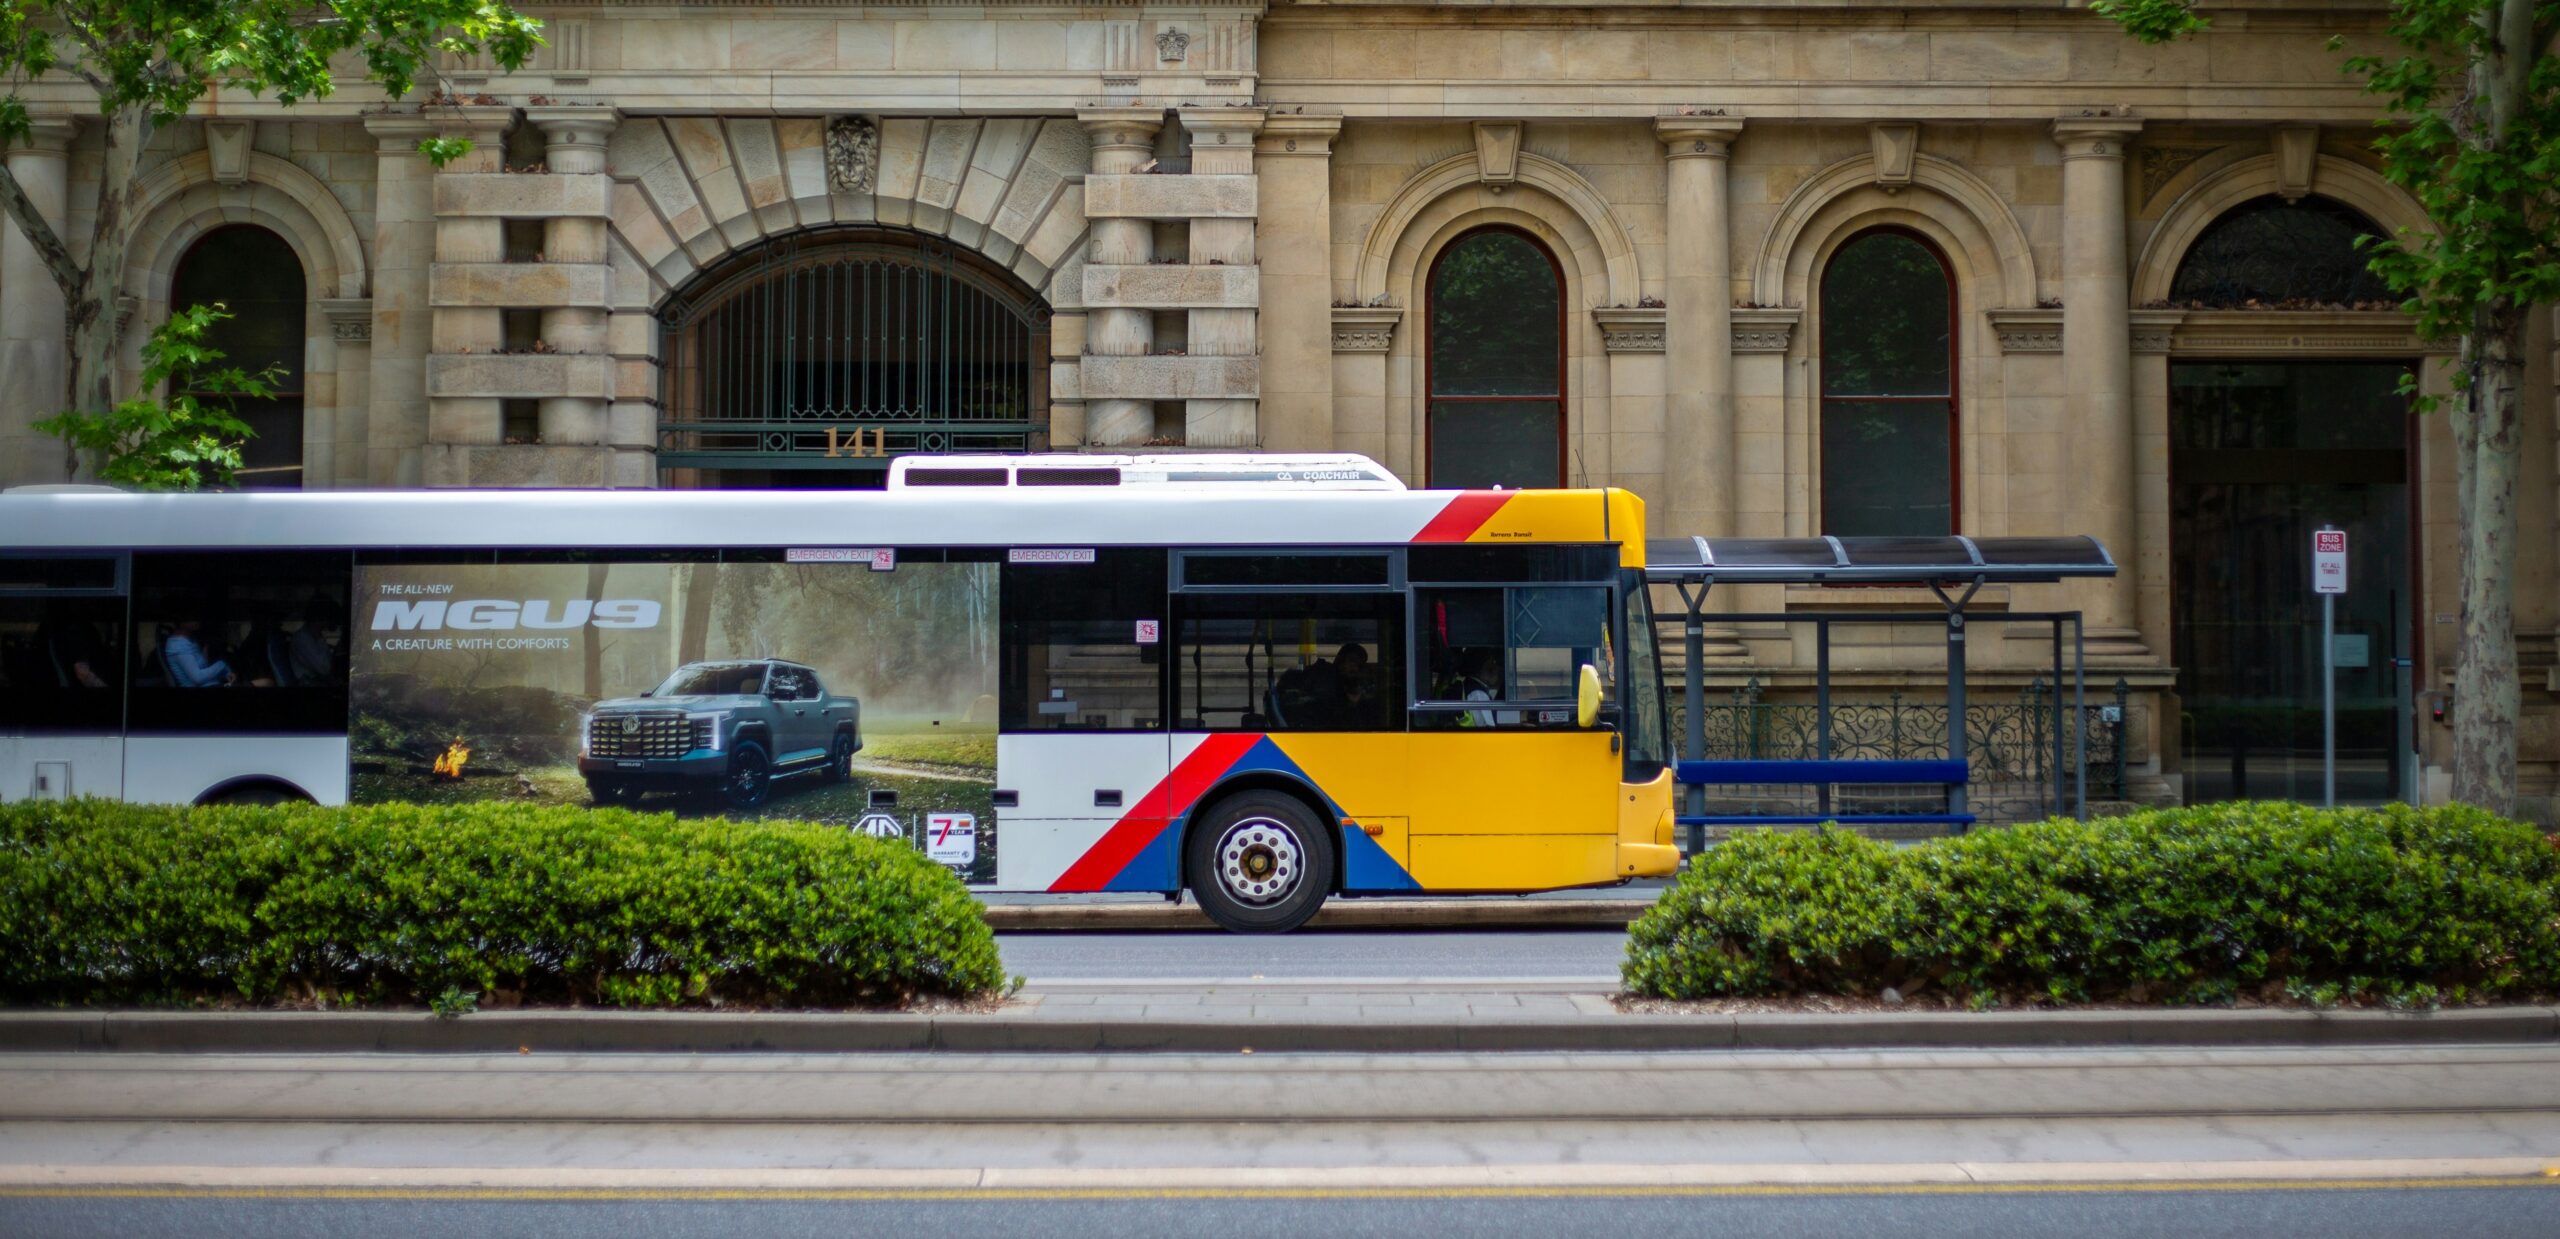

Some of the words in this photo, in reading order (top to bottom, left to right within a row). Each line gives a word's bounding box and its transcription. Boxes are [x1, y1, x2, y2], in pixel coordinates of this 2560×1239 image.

[824, 427, 888, 457] 141
[2321, 534, 2340, 543] BUS
[2320, 543, 2342, 551] ZONE
[789, 550, 848, 560] EMERGENCY
[851, 550, 869, 560] EXIT
[1011, 551, 1070, 560] EMERGENCY
[1073, 551, 1093, 560] EXIT
[381, 585, 402, 594] THE
[404, 584, 454, 594] ALL-NEW
[370, 600, 661, 631] MGU9
[371, 639, 382, 650] A
[385, 639, 453, 650] CREATURE
[456, 639, 493, 649] WITH
[496, 638, 569, 649] COMFORTS
[933, 819, 952, 846] 7
